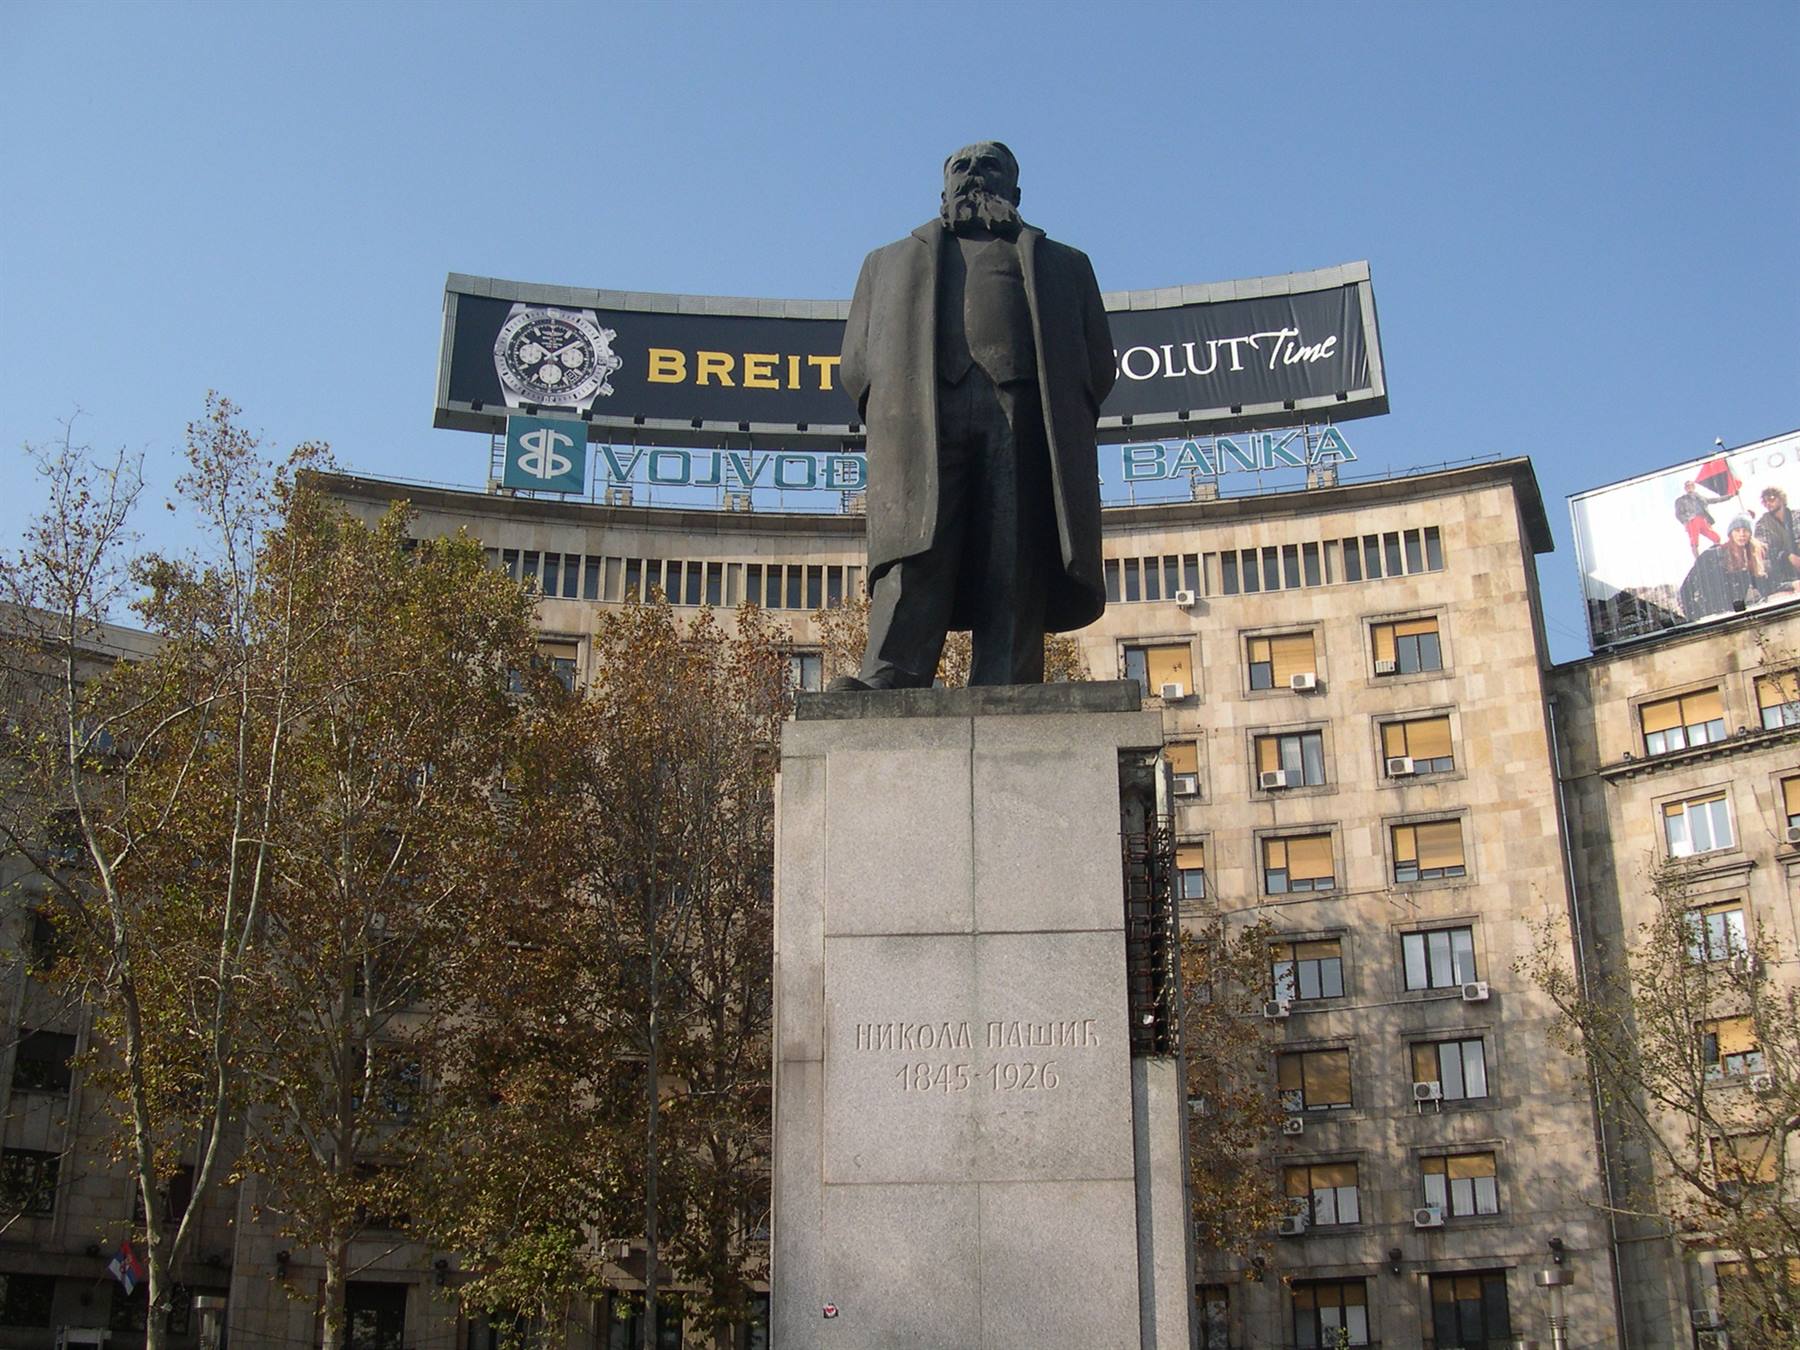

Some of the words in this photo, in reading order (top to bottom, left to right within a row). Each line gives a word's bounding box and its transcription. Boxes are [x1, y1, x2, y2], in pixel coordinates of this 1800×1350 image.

[1249, 327, 1338, 370] Time
[1121, 426, 1358, 482] BANKA
[856, 1021, 974, 1051] НИКОЛА
[987, 1018, 1100, 1049] ПАШИЋ
